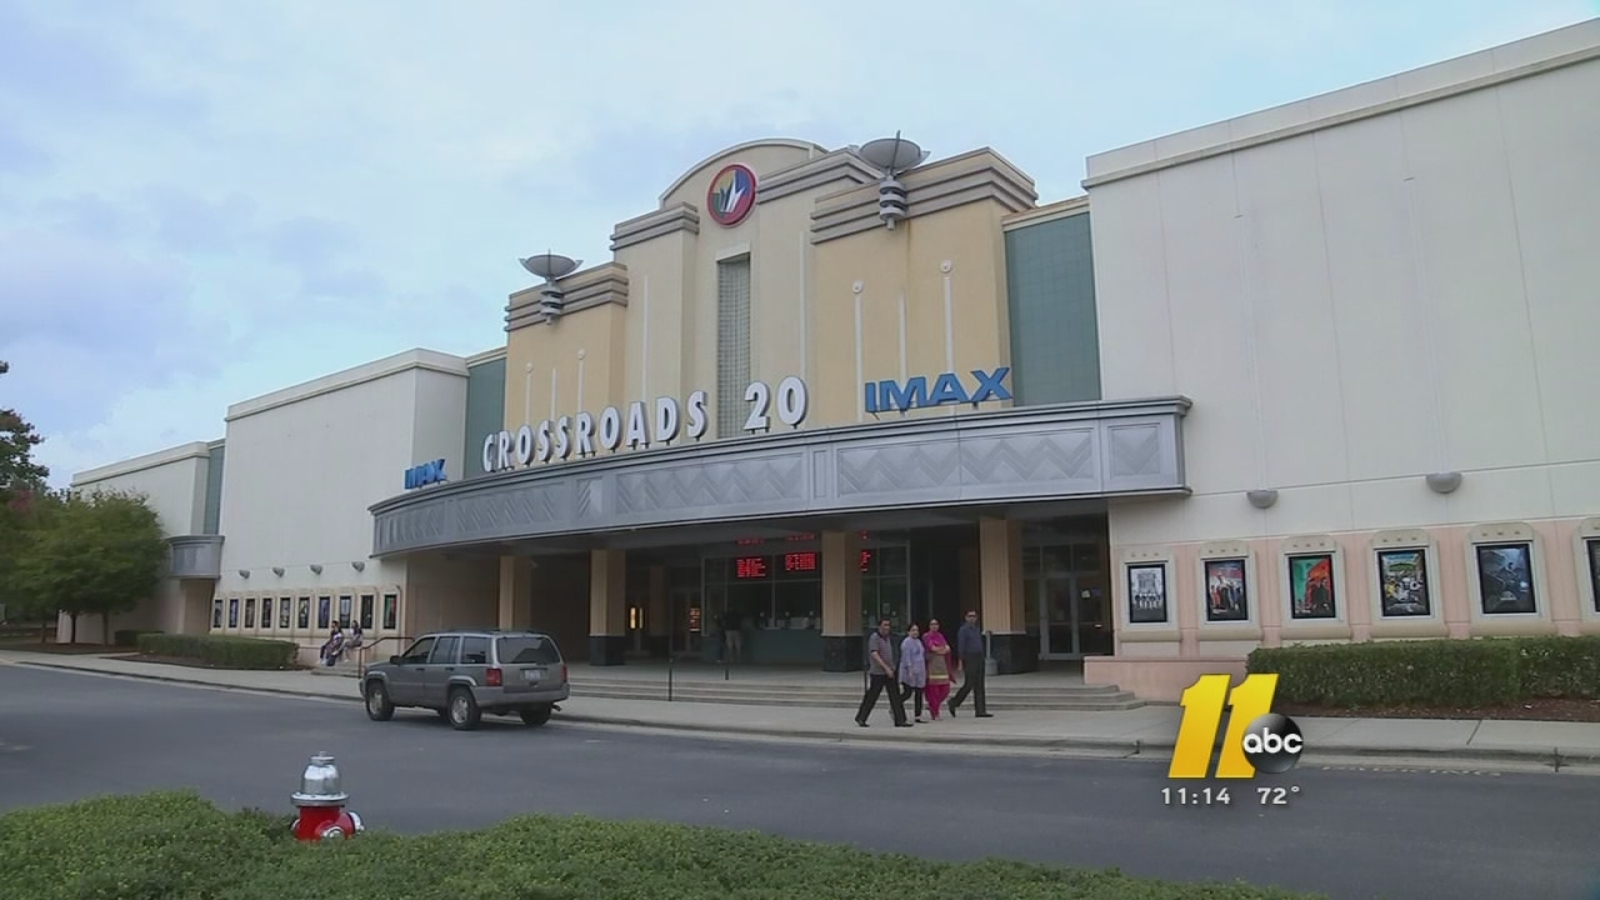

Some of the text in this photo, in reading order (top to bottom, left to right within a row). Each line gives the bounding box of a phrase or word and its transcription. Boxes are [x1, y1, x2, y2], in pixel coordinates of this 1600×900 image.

[865, 367, 1012, 413] IMAX
[482, 376, 808, 473] CROSSROADS 20
[404, 459, 447, 489] IMAX
